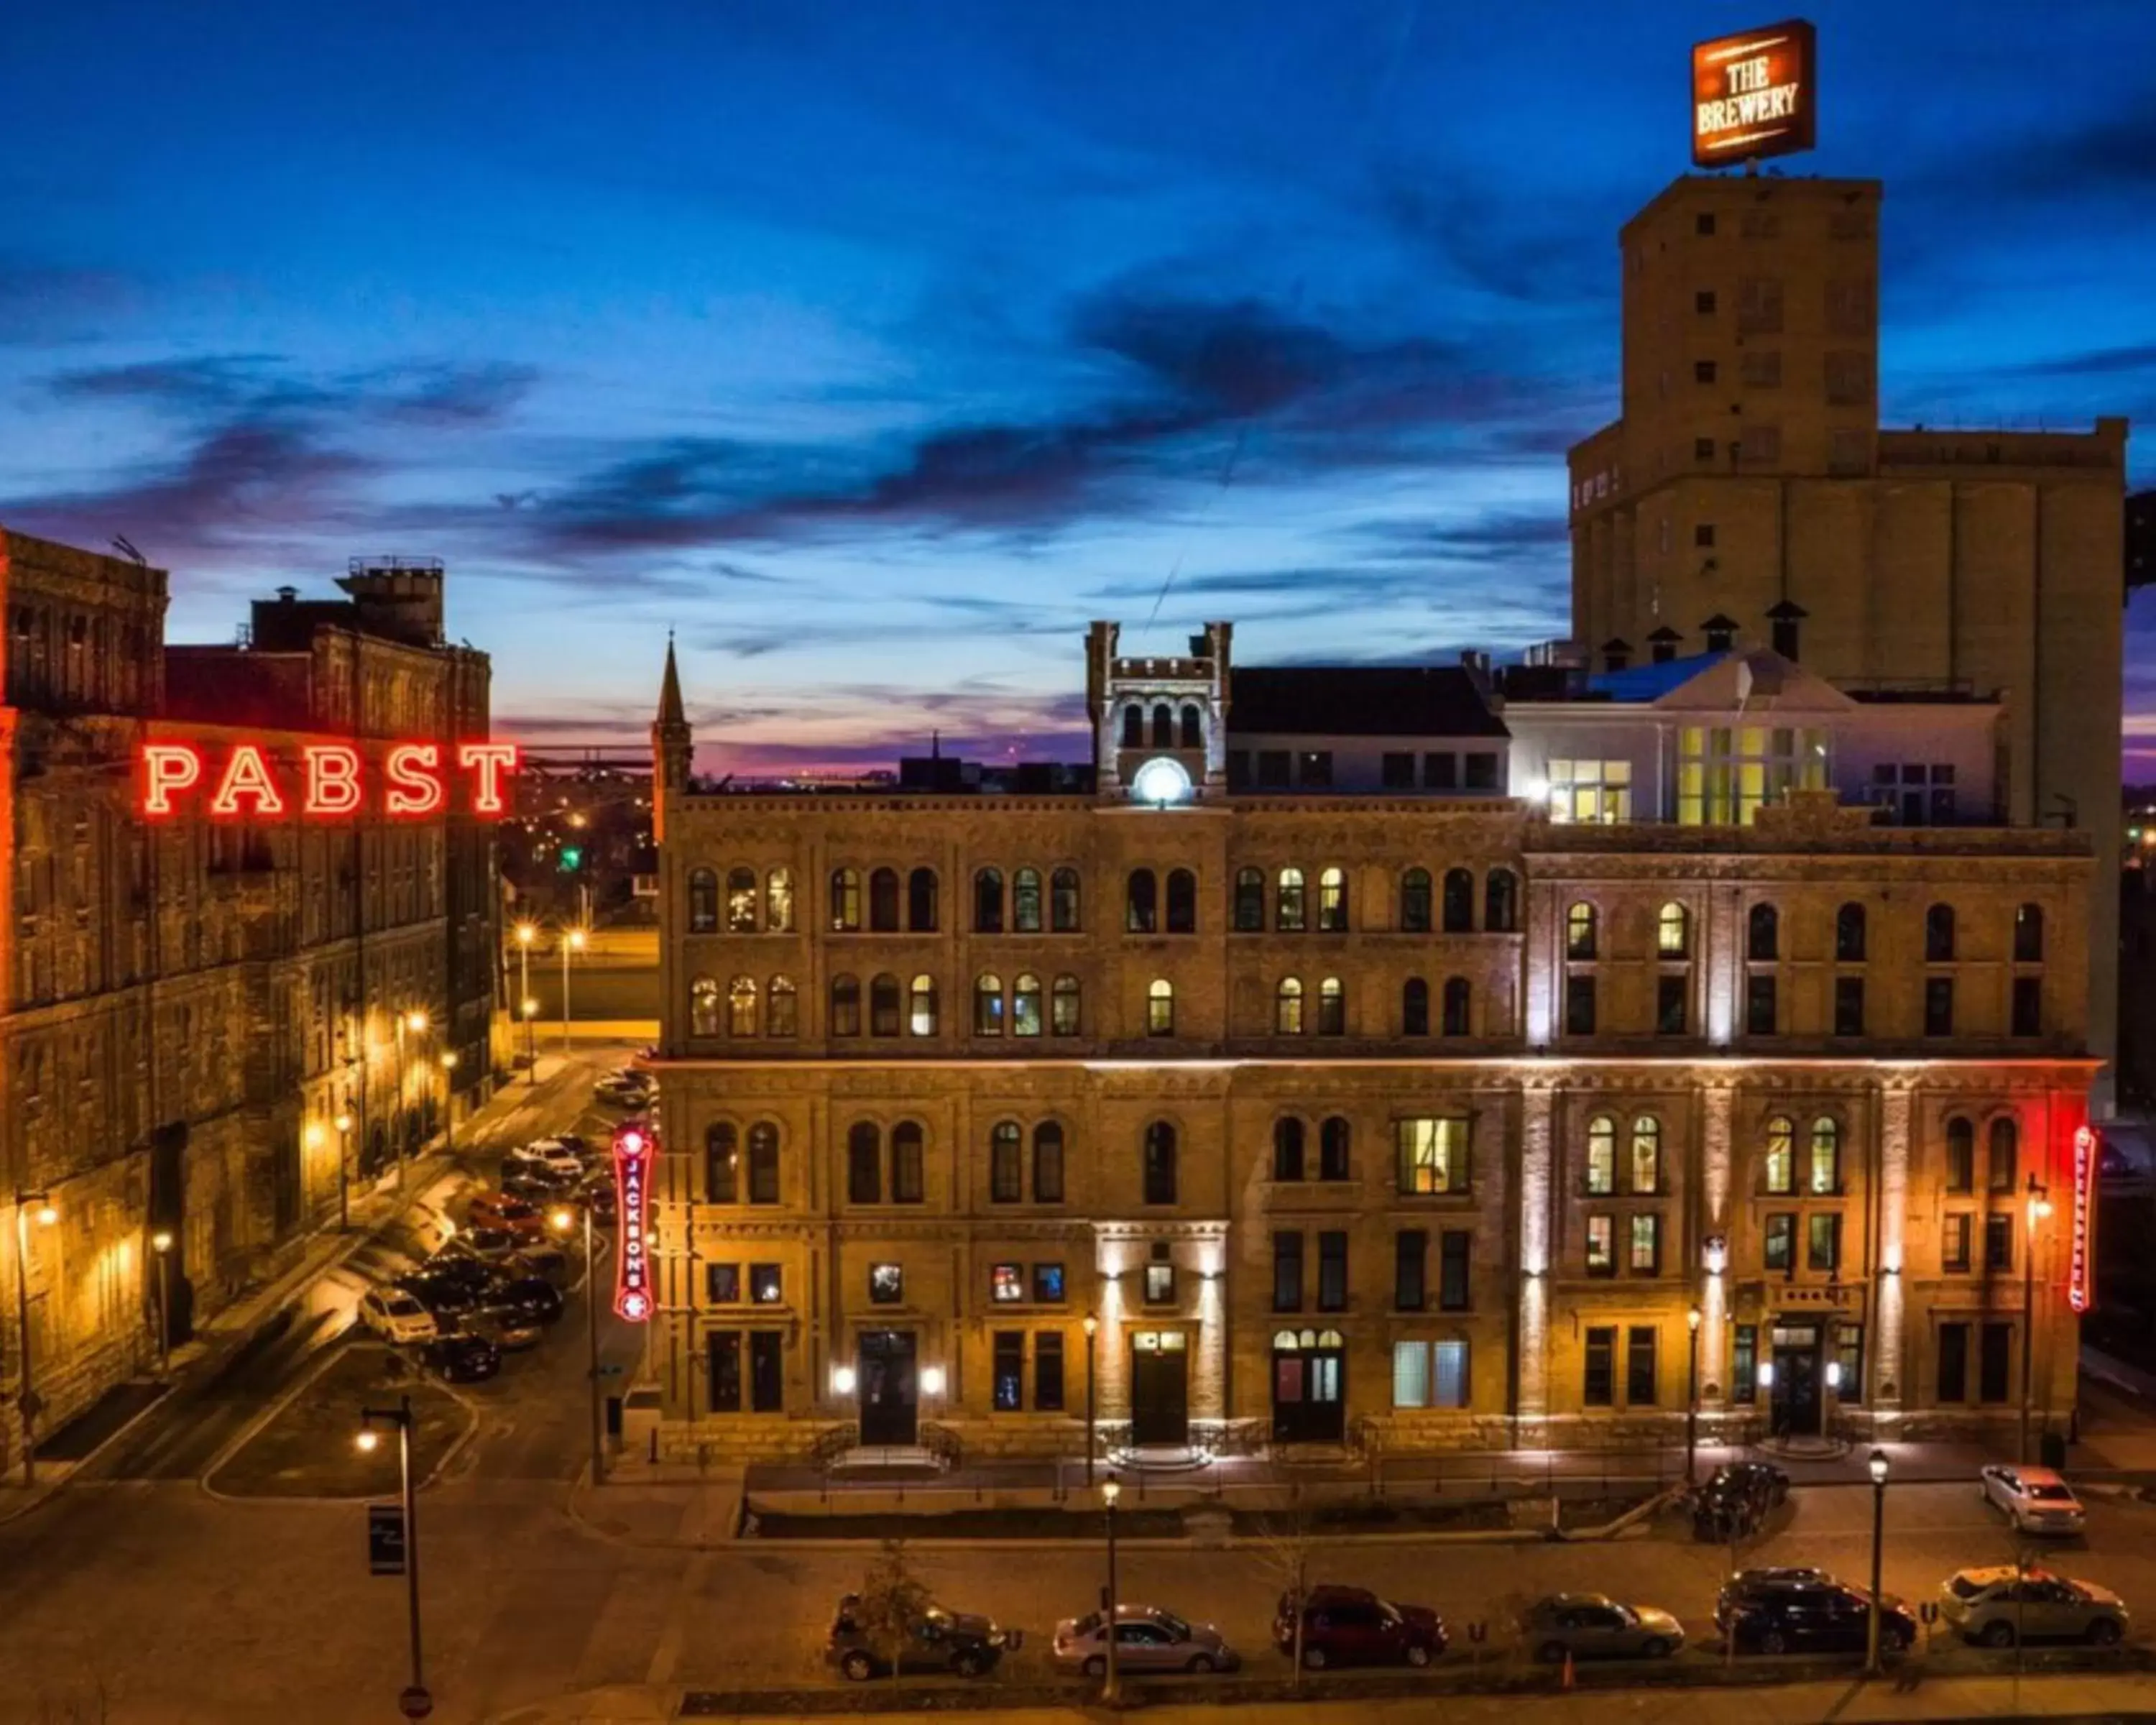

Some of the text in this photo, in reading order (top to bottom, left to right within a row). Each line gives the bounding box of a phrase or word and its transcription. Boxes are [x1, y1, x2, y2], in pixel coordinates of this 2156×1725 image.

[1726, 56, 1769, 93] THE
[1697, 82, 1799, 135] BREWERY
[144, 745, 517, 813] PABST
